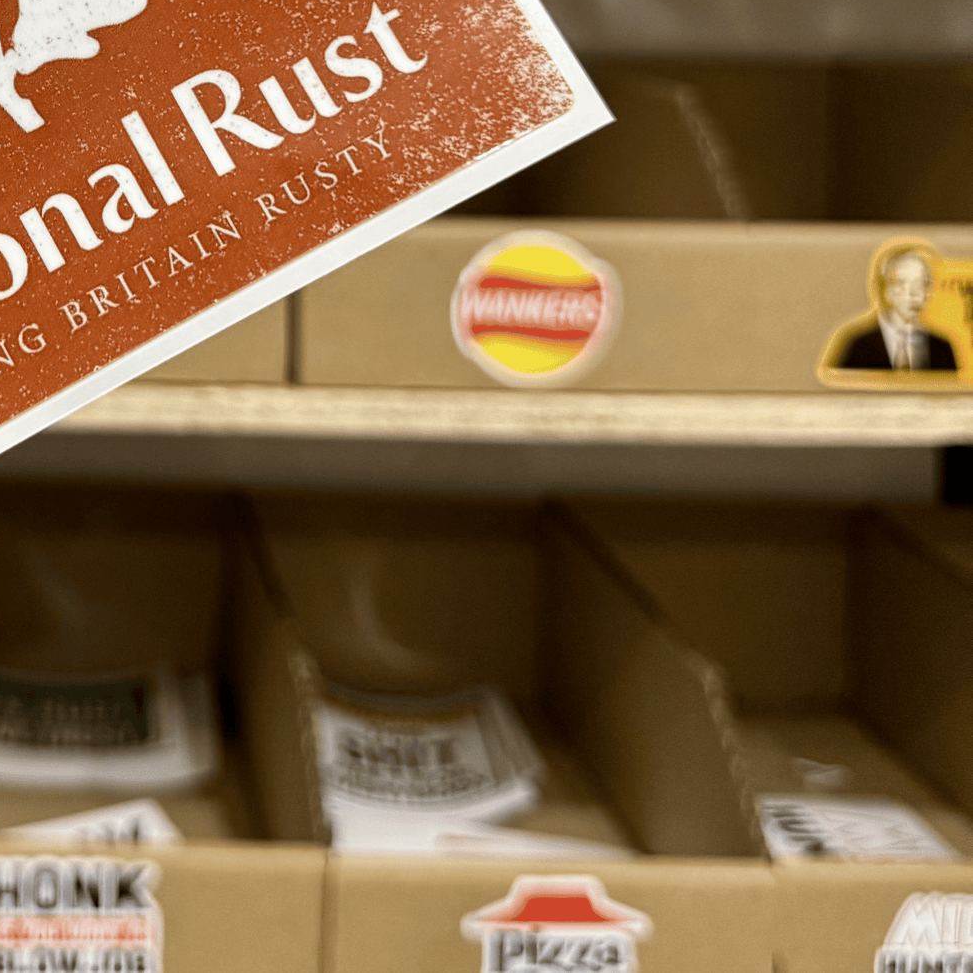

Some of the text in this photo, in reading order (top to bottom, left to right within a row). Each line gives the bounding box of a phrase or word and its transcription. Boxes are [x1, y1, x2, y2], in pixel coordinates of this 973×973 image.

[171, 1, 427, 177] Rust
[59, 214, 241, 331] BRITAIN
[254, 129, 393, 224] RUSTY
[460, 289, 596, 328] WANKERS
[489, 925, 621, 972] Pizza
